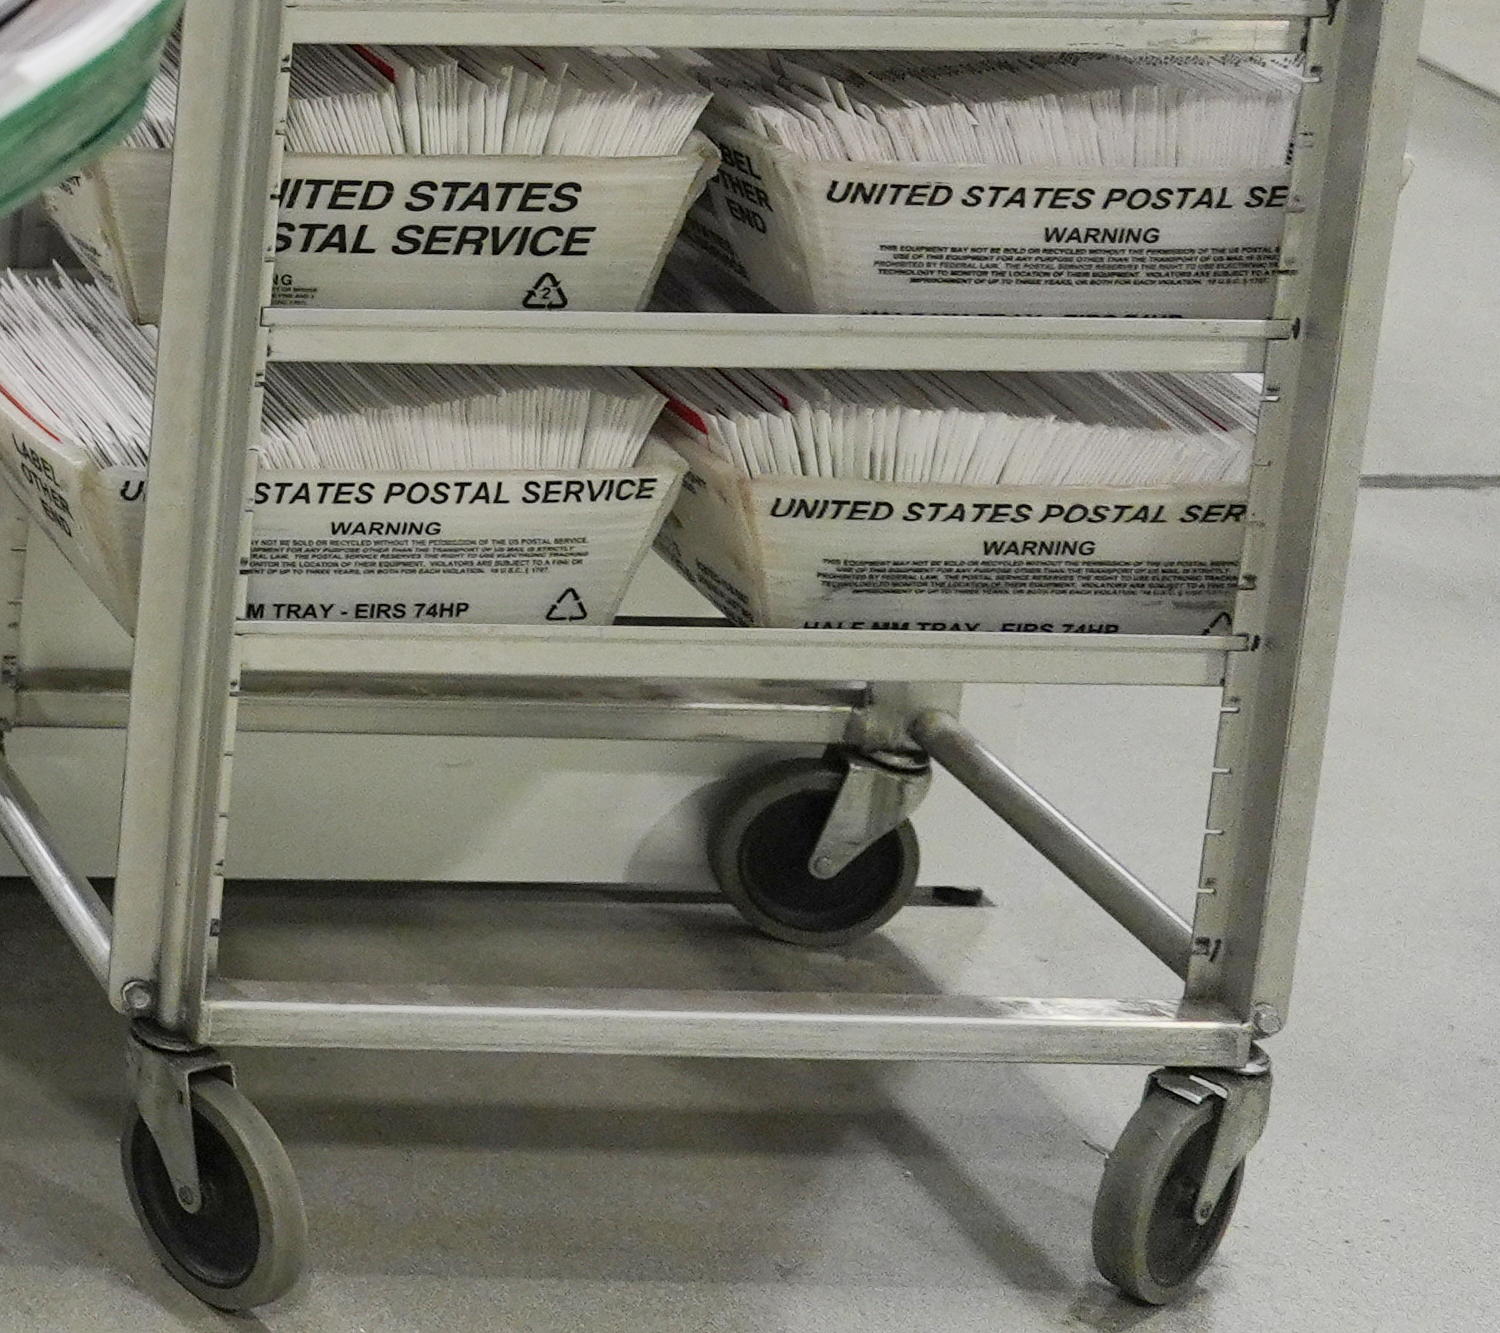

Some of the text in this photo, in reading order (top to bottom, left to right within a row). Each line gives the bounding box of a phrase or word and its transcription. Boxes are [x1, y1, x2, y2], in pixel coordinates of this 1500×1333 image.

[404, 180, 582, 213] STATES
[826, 179, 1233, 211] UNITED STATES POSTAL
[391, 224, 597, 257] SERVICE
[1044, 227, 1160, 244] WARNING
[254, 477, 658, 505] STATES POSTAL SERVICE
[769, 497, 1168, 524] UNITED STATES POSTAL
[330, 521, 442, 536] WARNING
[983, 540, 1096, 557] WARNING
[272, 602, 470, 620] TRAY EIRS 74HP
